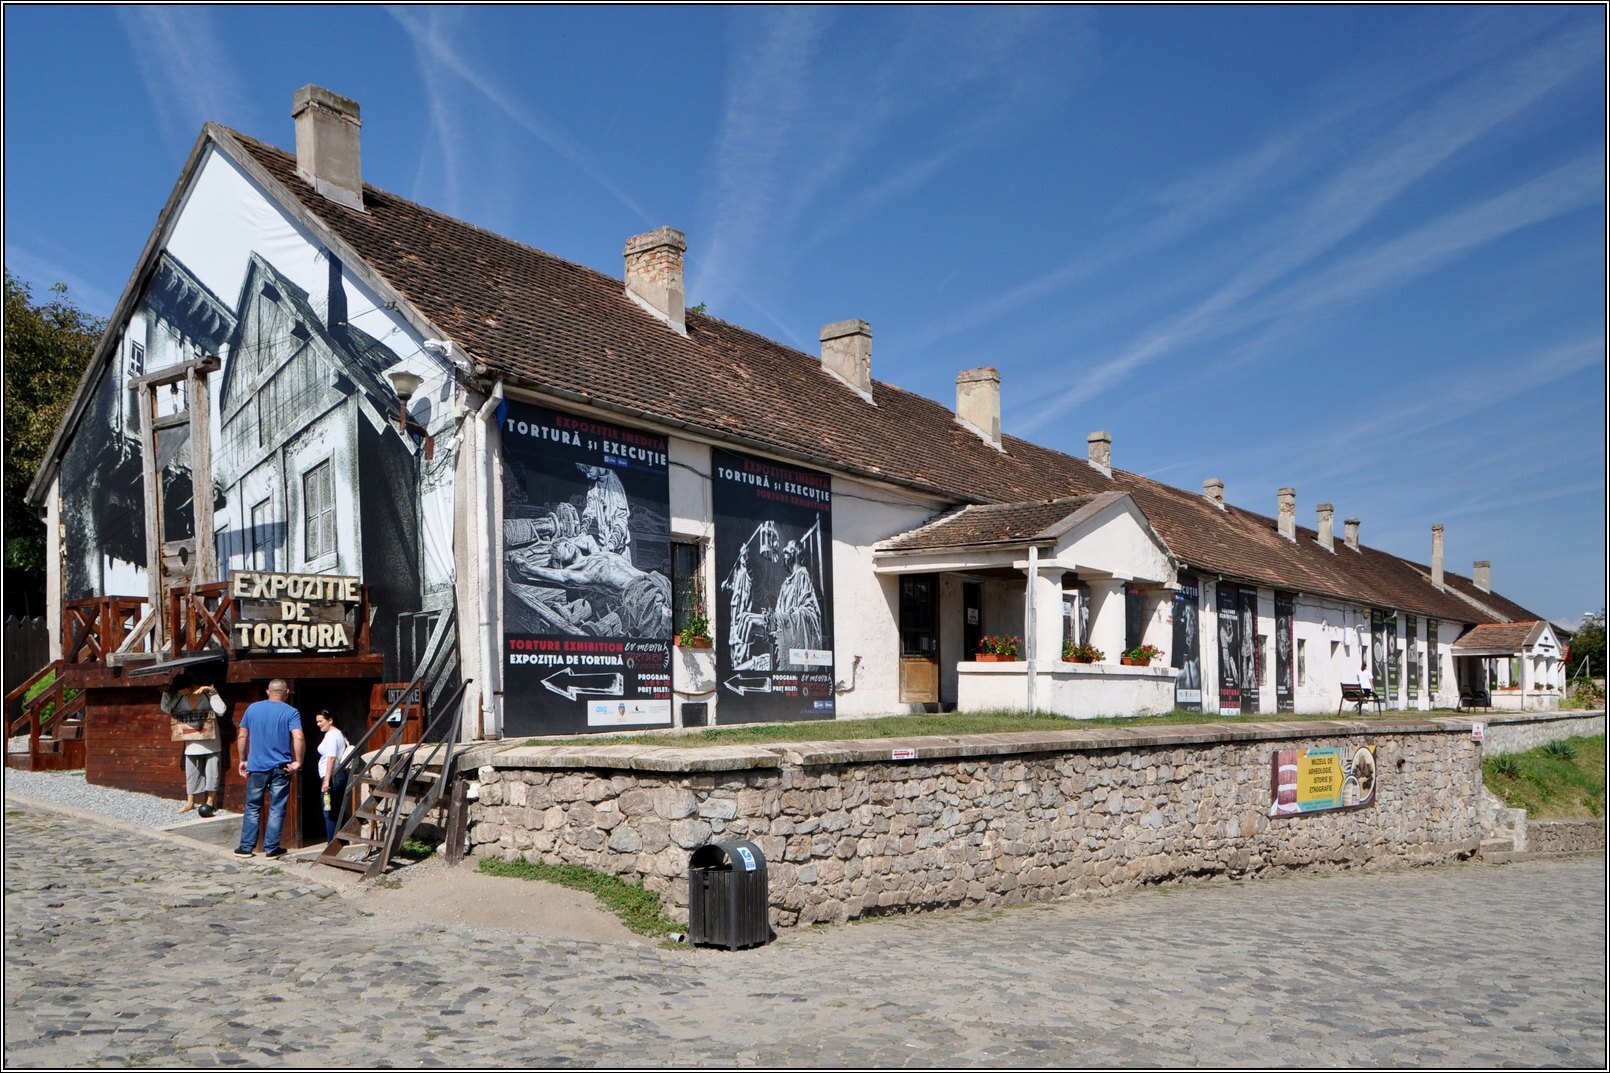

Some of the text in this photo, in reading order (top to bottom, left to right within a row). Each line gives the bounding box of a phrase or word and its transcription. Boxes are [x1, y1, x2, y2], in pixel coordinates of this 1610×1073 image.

[507, 418, 581, 447] TORTURĂ
[603, 440, 667, 467] EXECUȚIE
[718, 467, 770, 488] TORTURĂ
[784, 482, 830, 502] EXECUȚIE
[233, 572, 361, 601] EXPOZITIE
[281, 601, 311, 622] DE
[234, 622, 349, 648] TORTURA
[509, 639, 623, 653] TORTURE EXHIBITION
[509, 653, 624, 668] EXPOZIȚIA DE TORTURĂ
